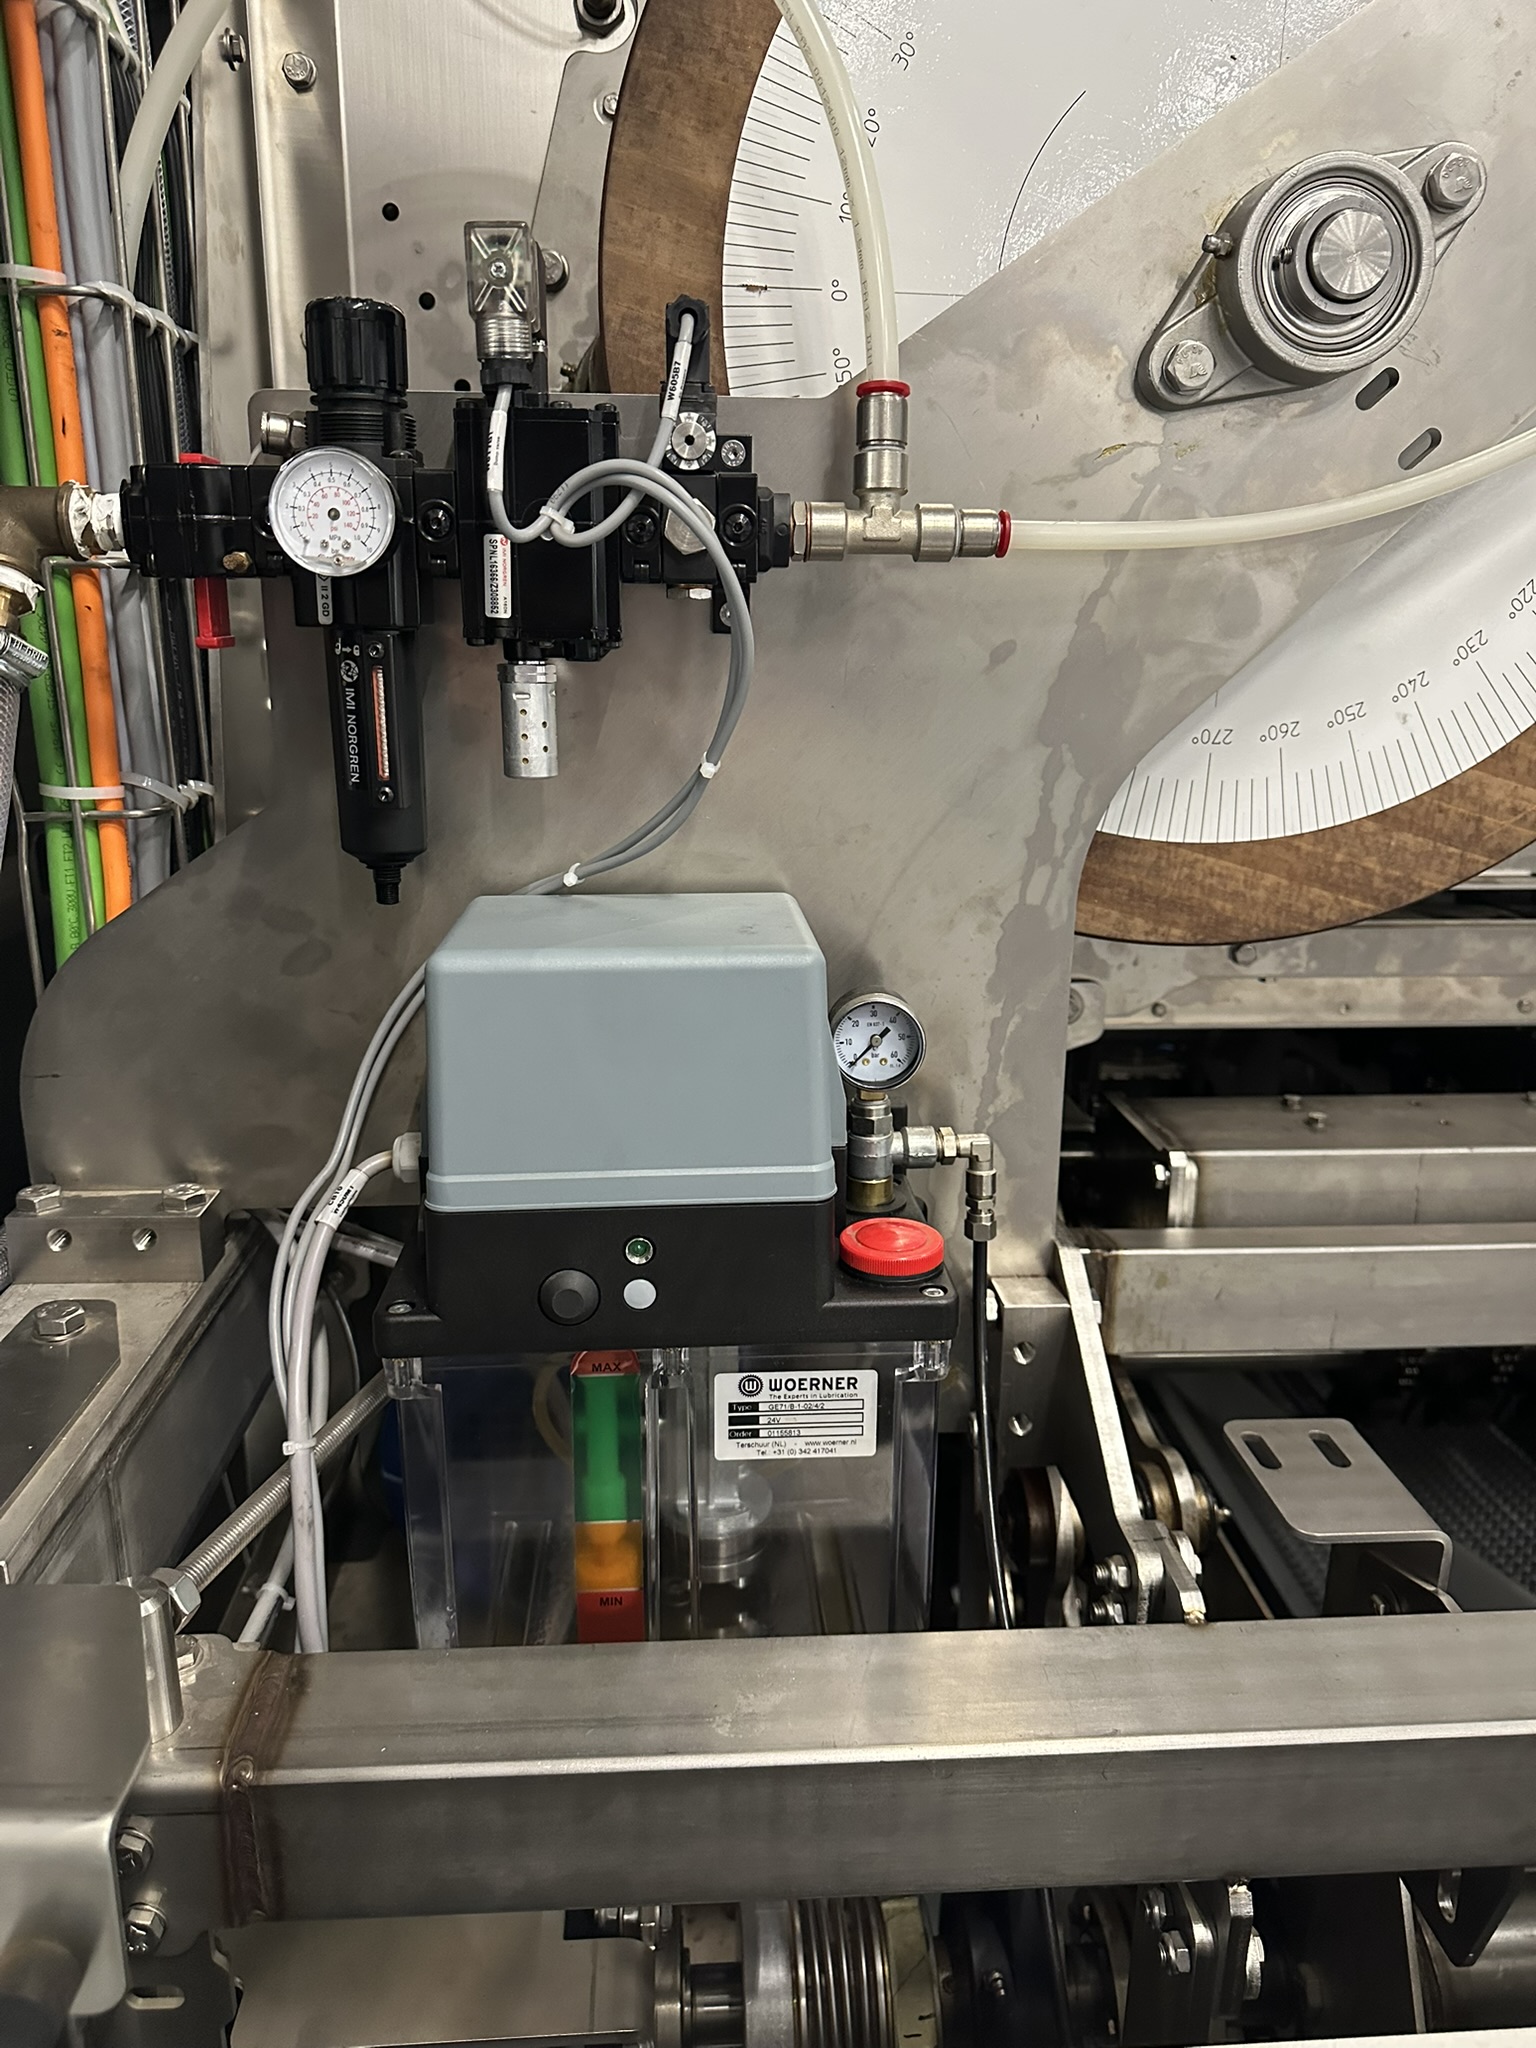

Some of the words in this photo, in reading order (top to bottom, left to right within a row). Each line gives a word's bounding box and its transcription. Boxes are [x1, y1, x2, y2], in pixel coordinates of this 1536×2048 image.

[891, 32, 916, 71] 30°
[831, 279, 848, 302] 0°
[667, 360, 681, 401] W605B7
[322, 603, 330, 617] GD
[1452, 630, 1489, 666] 230°
[1391, 670, 1430, 703] 240°
[345, 688, 355, 710] IMI
[1326, 701, 1367, 728] 250°
[1192, 728, 1234, 746] 270°
[1259, 720, 1300, 743] 260°
[347, 714, 360, 783] NORGREN
[592, 1362, 622, 1373] MAX
[768, 1377, 858, 1392] WOERNER
[600, 1596, 623, 1606] MIN
